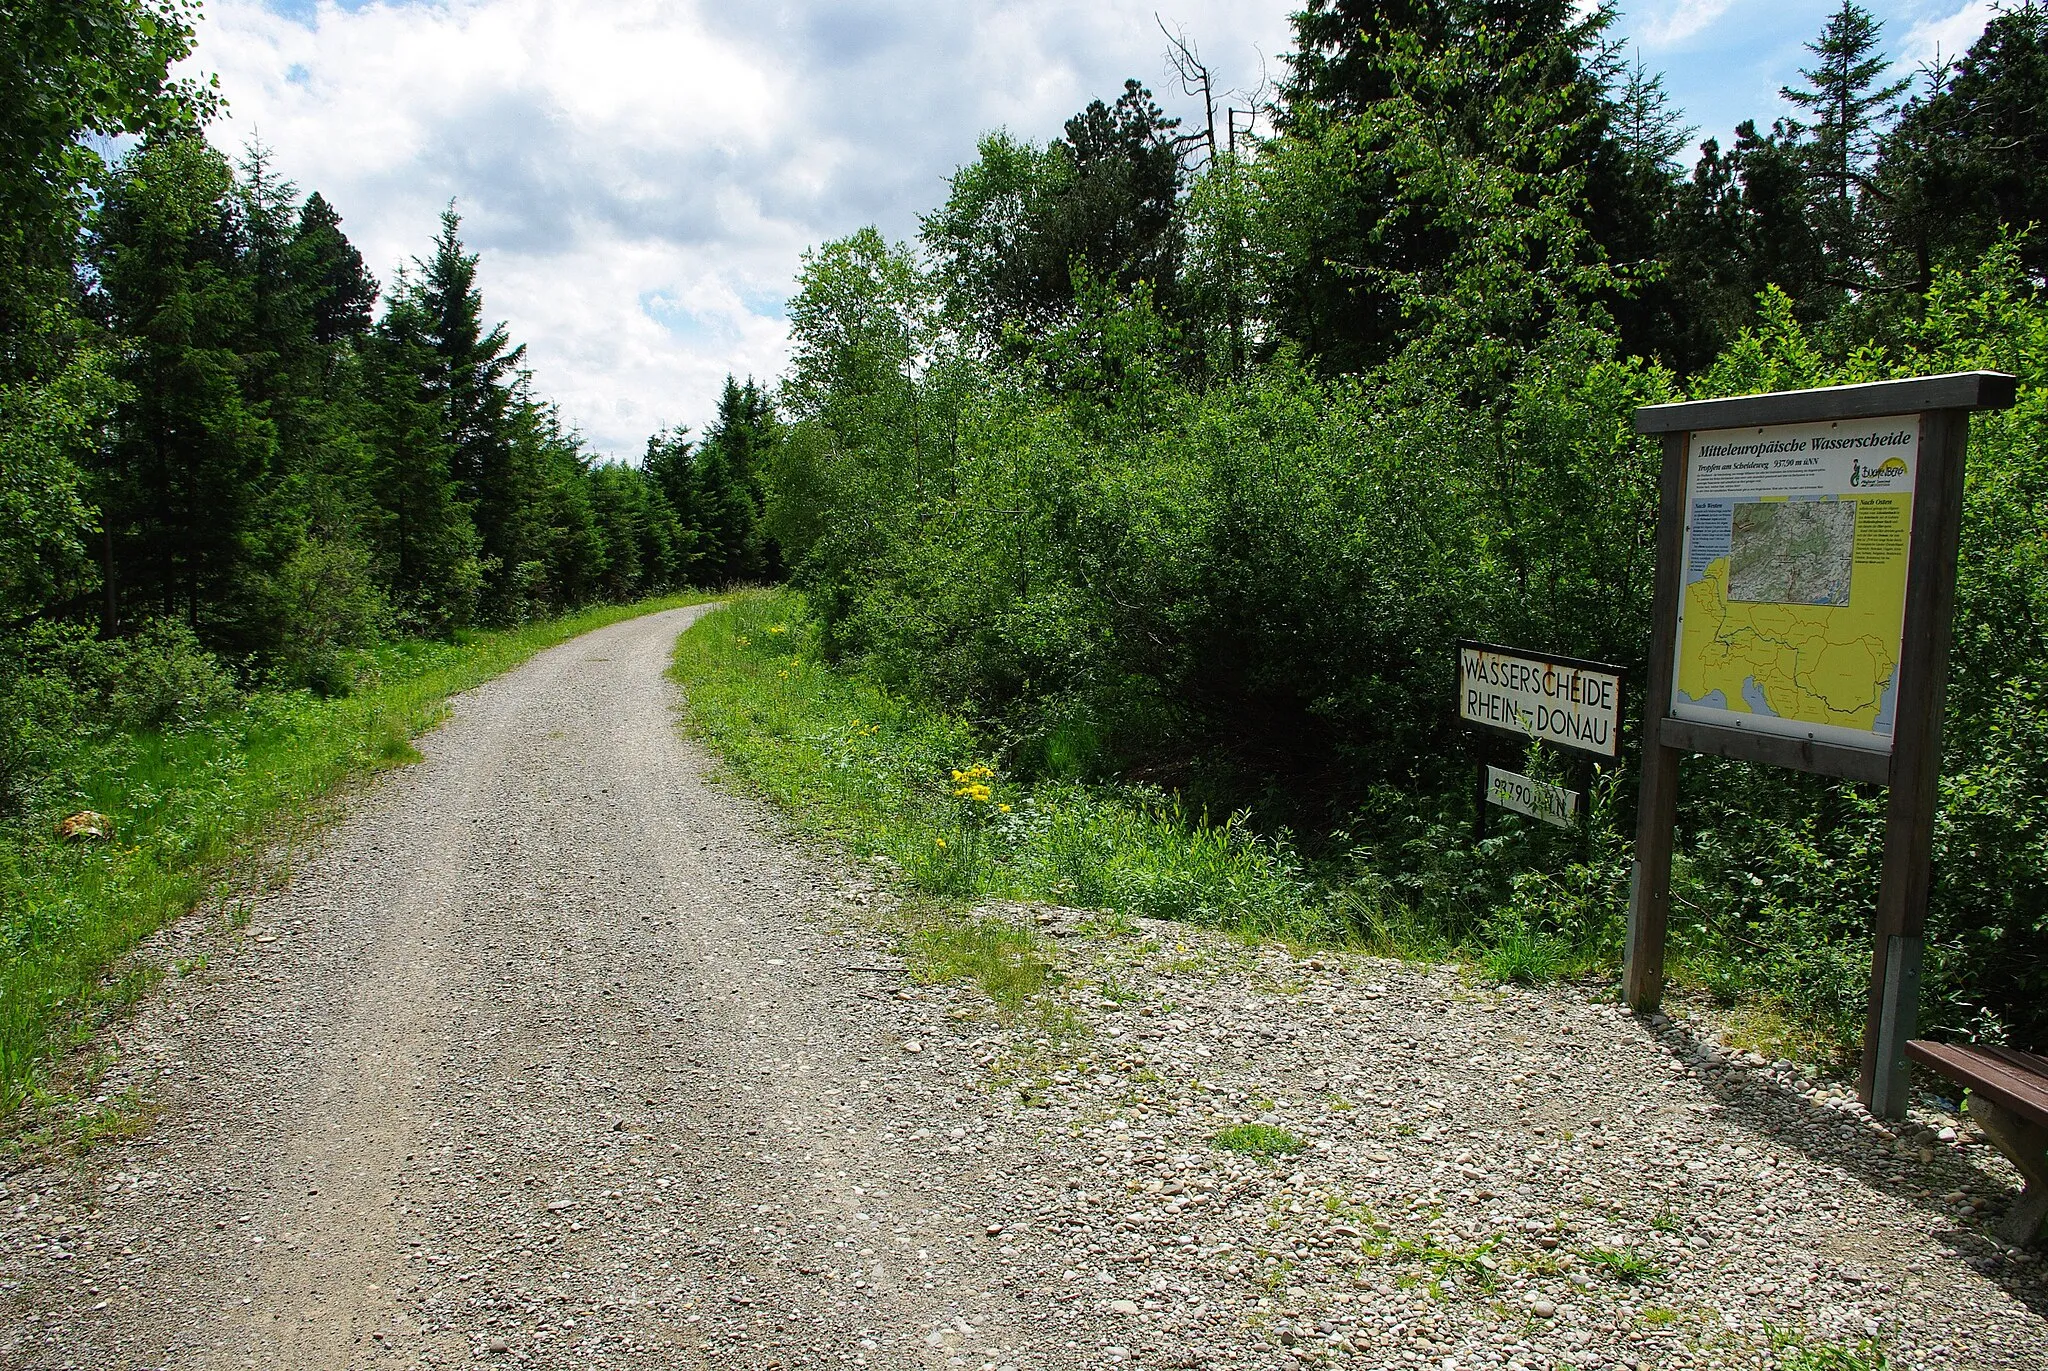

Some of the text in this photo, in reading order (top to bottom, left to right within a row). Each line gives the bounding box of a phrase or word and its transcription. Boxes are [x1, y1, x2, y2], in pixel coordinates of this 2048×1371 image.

[1698, 431, 1911, 457] Mitteleuropäische Wasserscheide
[1464, 655, 1613, 711] WASSERSCHEIDE
